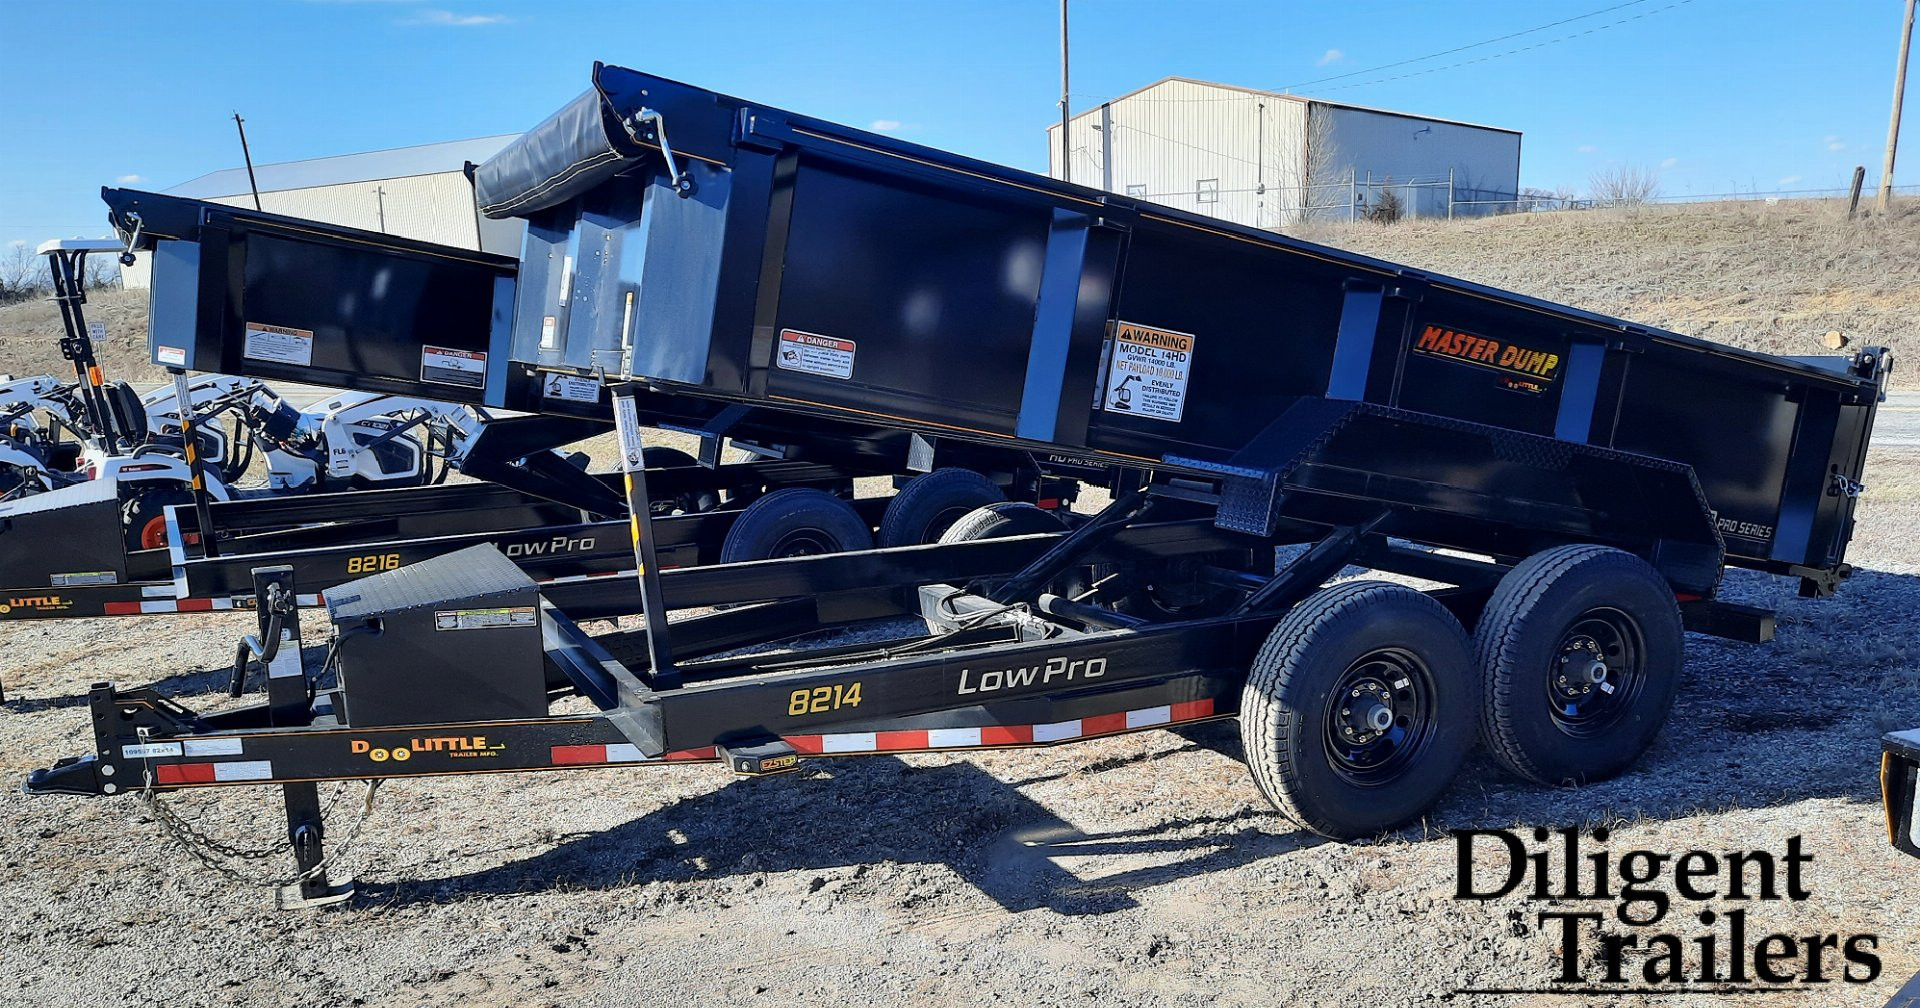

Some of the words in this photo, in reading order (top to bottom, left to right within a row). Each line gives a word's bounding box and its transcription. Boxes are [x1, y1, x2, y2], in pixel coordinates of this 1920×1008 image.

[806, 336, 839, 348] DANGER
[1133, 329, 1187, 350] WARNING
[444, 350, 473, 358] DANGER
[1120, 343, 1157, 357] MODEL
[1161, 351, 1187, 362] 14HD
[1127, 354, 1147, 362] GVWR
[1417, 326, 1499, 363] MASTER
[1500, 345, 1559, 375] DUMP
[1116, 360, 1128, 371] NET
[1128, 362, 1155, 375] PAYLOAD
[1141, 386, 1181, 397] DISTRIBUTED
[1151, 380, 1174, 388] EVENLY
[1717, 518, 1738, 532] PRO
[1738, 522, 1773, 538] SERIES
[347, 553, 401, 574] 8216
[788, 682, 862, 716] 8214
